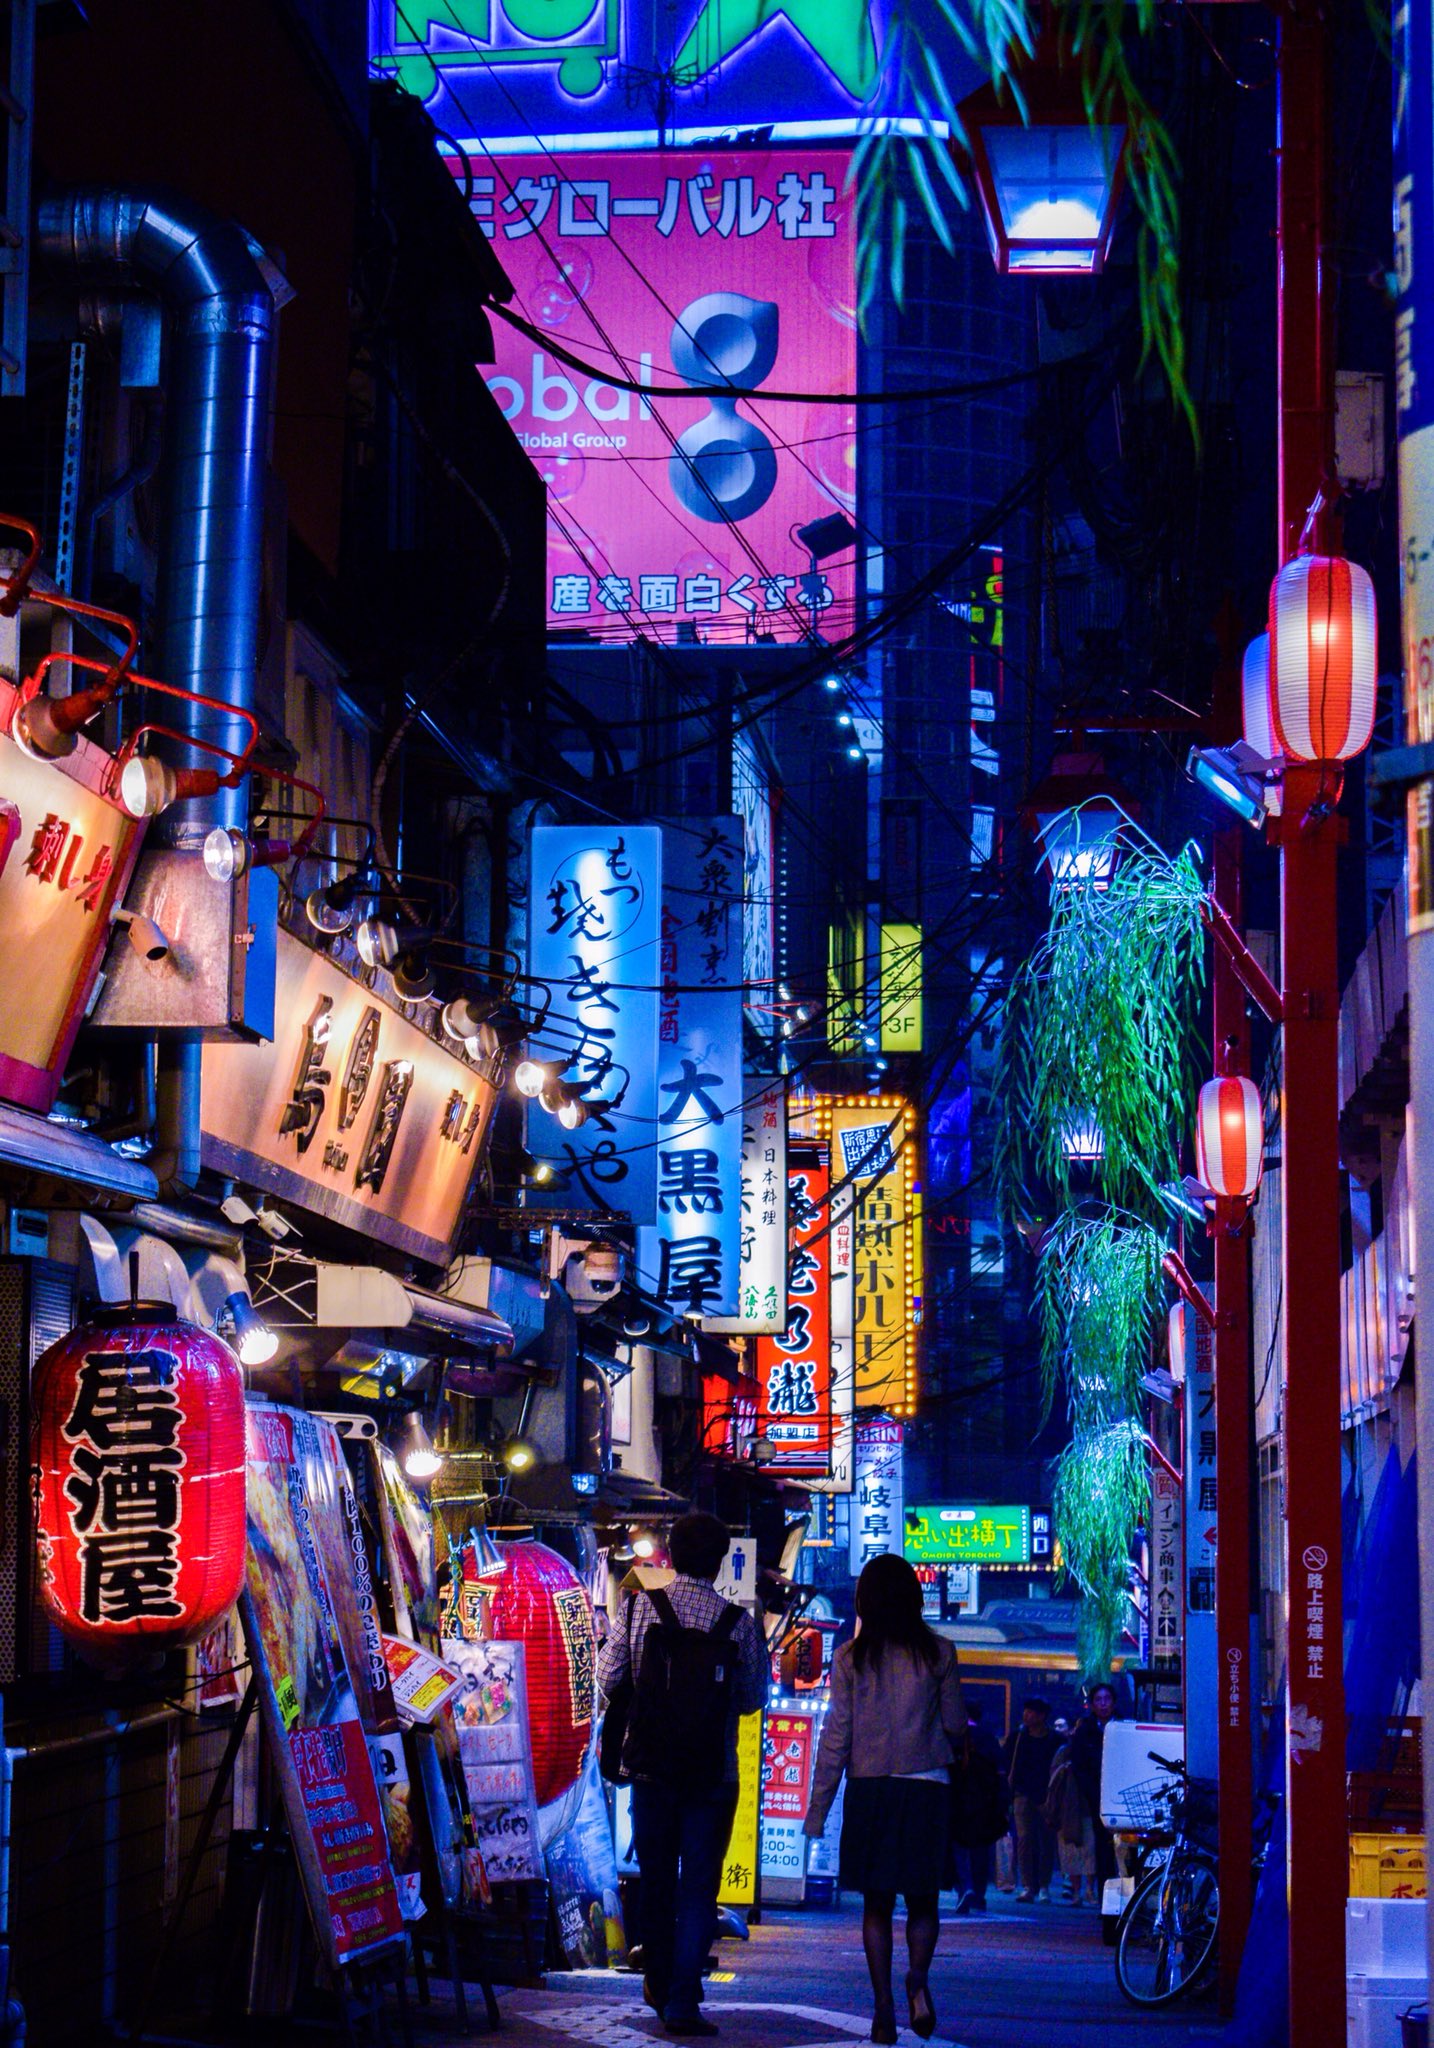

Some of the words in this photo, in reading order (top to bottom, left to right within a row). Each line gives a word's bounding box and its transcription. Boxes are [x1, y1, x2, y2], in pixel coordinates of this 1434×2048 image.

[572, 433, 627, 450] Group
[888, 1017, 915, 1033] 3F
[658, 1059, 724, 1302] 大黒屋
[62, 1350, 187, 1624] 居酒屋
[904, 1518, 1018, 1549] 思い出横丁
[1033, 1515, 1048, 1554] 西口
[1306, 1573, 1324, 1640] 路上喫煙
[1306, 1645, 1324, 1679] 禁止
[763, 1827, 795, 1838] 業時間
[761, 1854, 800, 1866] 24:00
